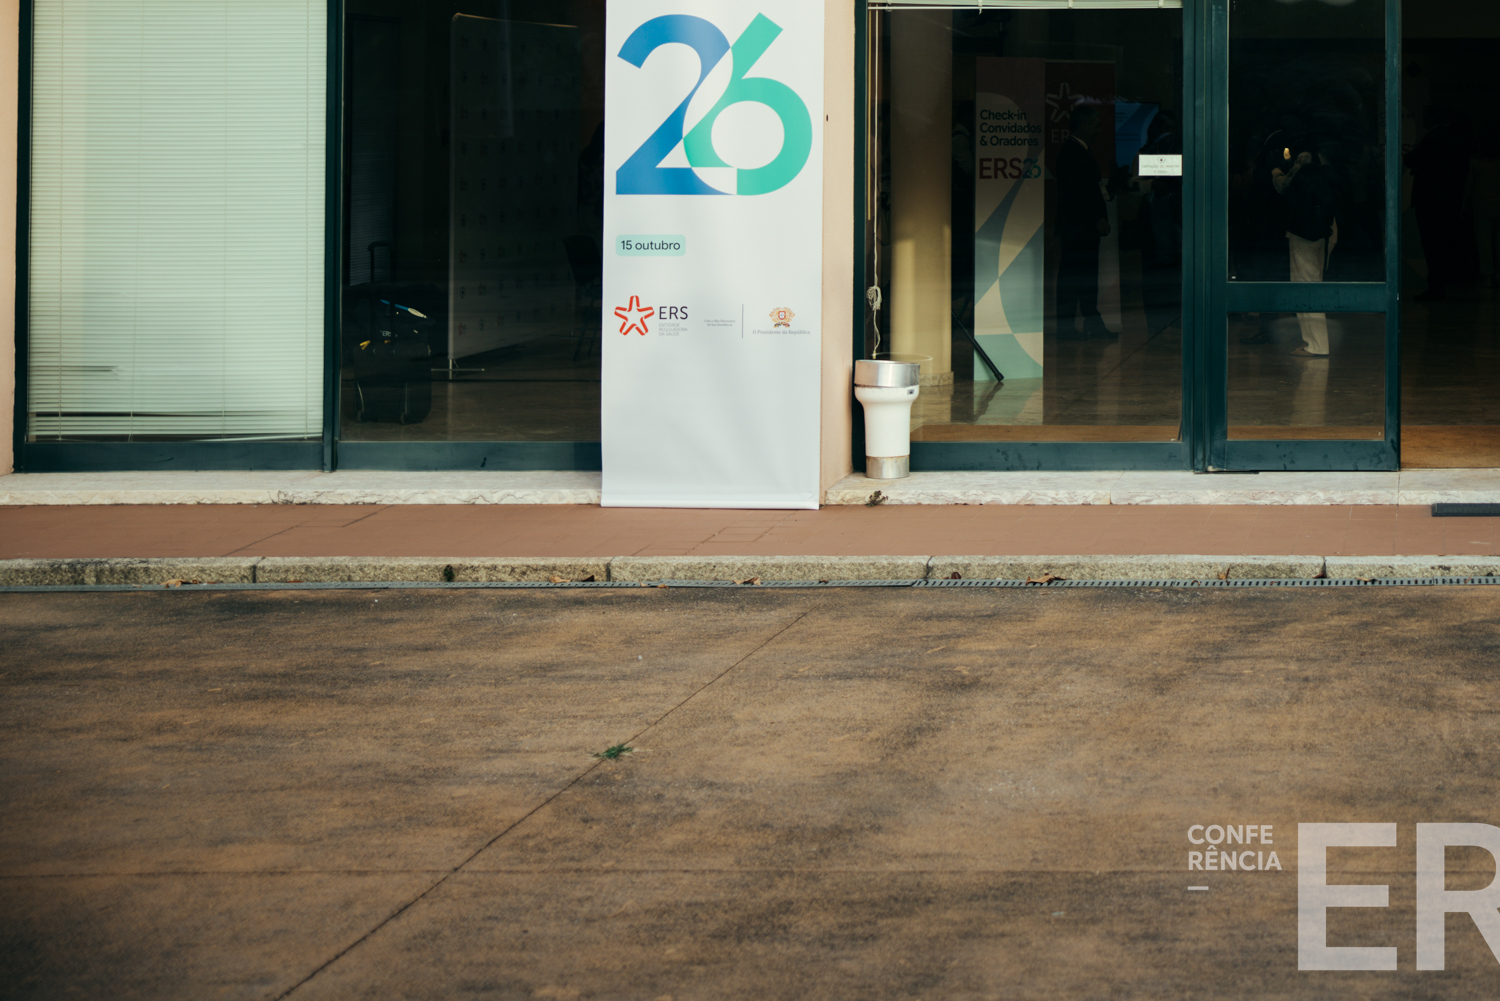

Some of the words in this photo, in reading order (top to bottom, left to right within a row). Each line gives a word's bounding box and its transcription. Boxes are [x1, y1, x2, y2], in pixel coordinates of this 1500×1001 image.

[980, 109, 1027, 121] Check-in
[980, 122, 1042, 134] Convidados
[980, 135, 988, 146] &
[989, 135, 1039, 146] Oradores
[979, 157, 1042, 179] ERS26
[620, 240, 633, 250] 15
[635, 240, 681, 250] outubro
[659, 306, 688, 320] ERS
